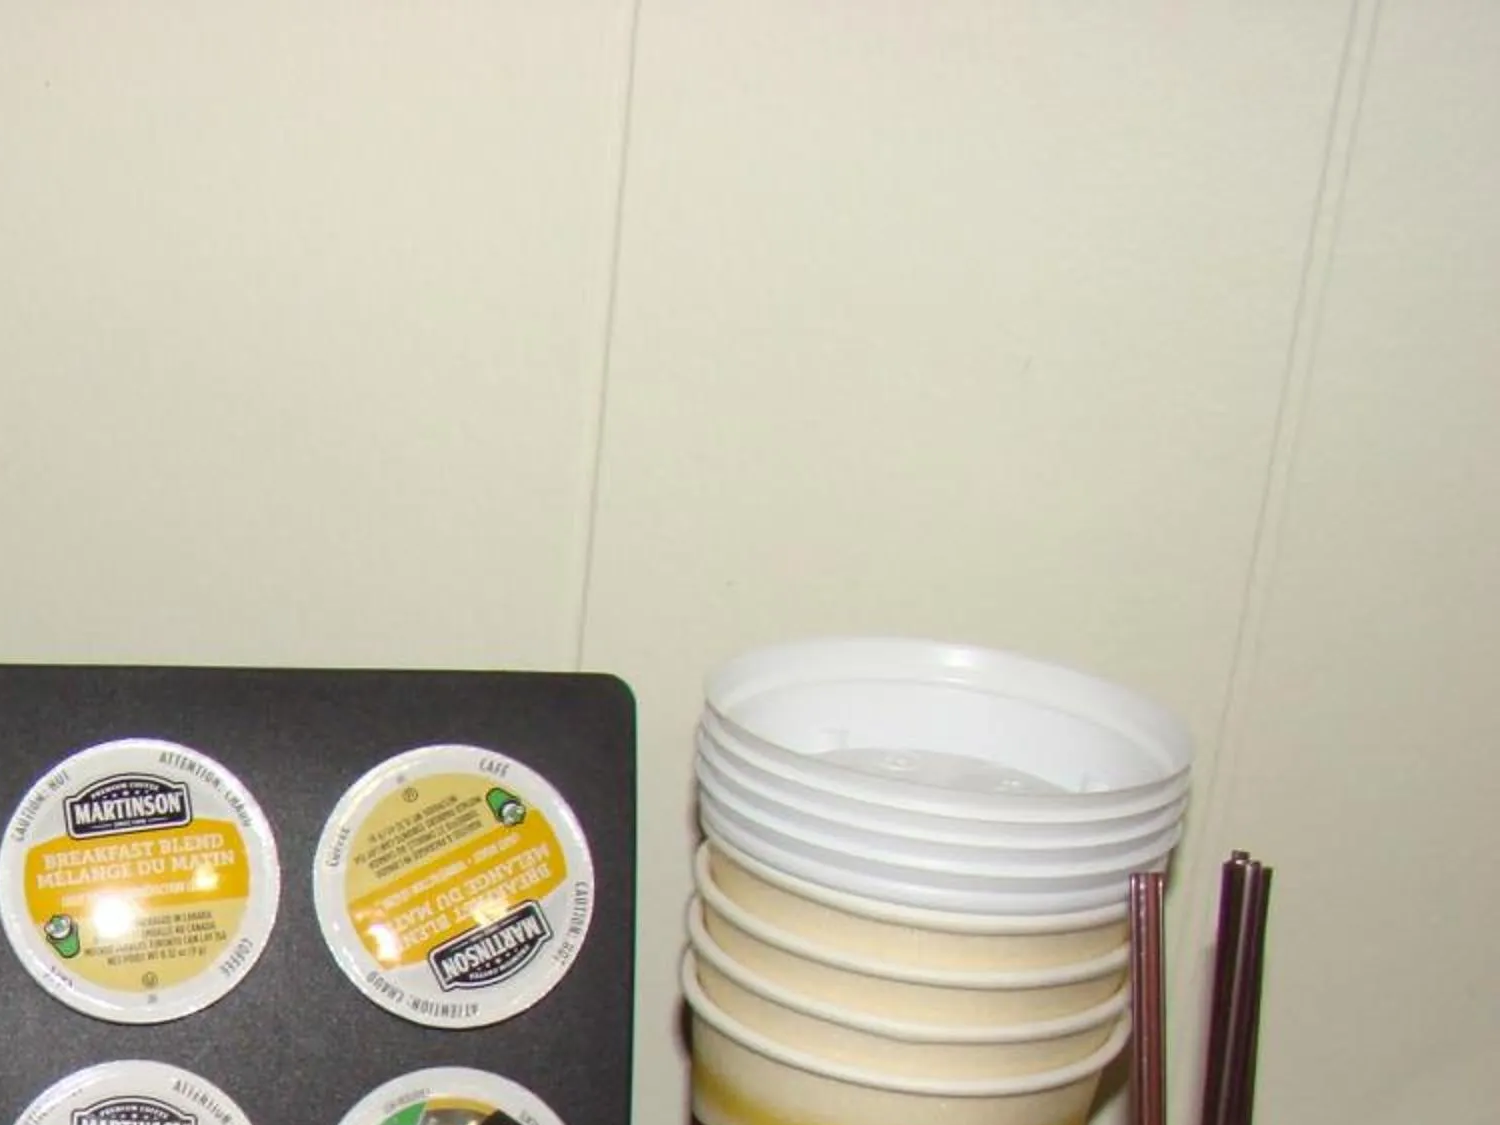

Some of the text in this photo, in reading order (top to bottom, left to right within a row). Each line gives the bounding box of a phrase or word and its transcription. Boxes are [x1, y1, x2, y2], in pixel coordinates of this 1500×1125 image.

[74, 792, 182, 826] MARTINSON
[43, 833, 224, 871] BREAKFAST BLEND
[138, 858, 166, 875] DU
[440, 914, 542, 980] MARTINSON
